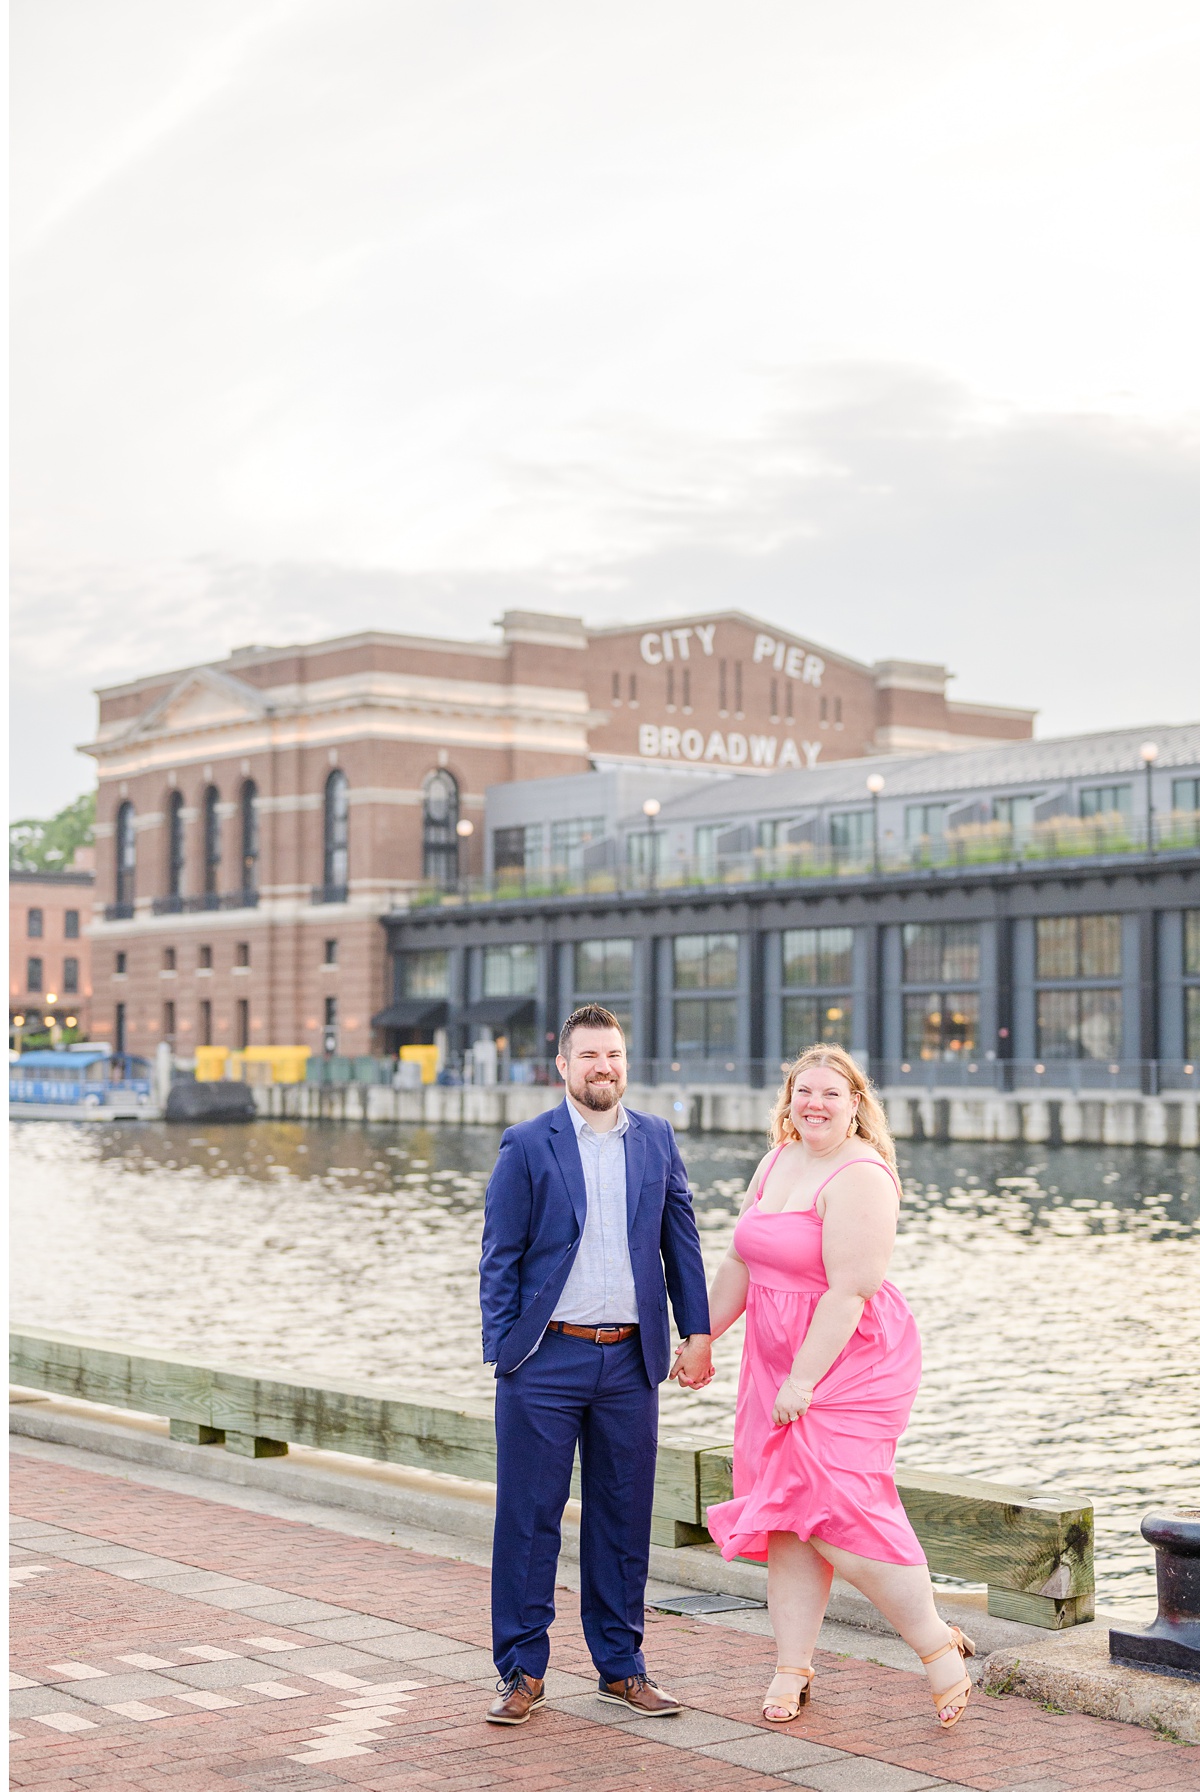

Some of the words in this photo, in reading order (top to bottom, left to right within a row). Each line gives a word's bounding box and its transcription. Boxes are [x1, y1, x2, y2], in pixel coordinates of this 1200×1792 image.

[640, 623, 716, 665] CITY
[753, 633, 825, 688] PIER
[638, 723, 822, 769] BROADWAY
